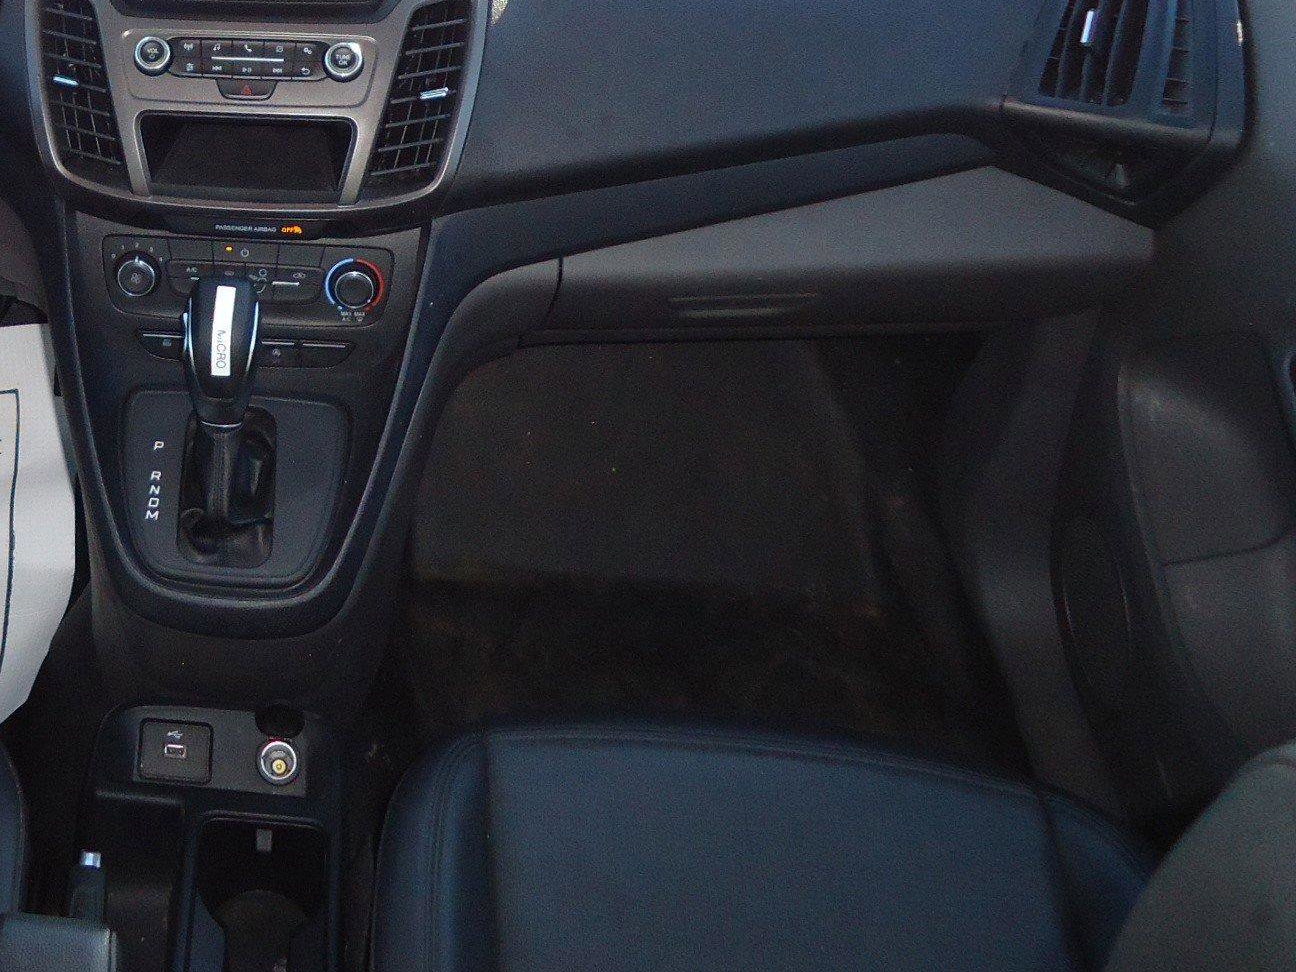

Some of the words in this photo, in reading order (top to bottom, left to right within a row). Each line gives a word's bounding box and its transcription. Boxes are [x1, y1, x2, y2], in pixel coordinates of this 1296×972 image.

[215, 224, 252, 232] PASSENGER
[154, 440, 164, 450] P
[150, 470, 161, 480] R
[149, 484, 160, 494] N
[148, 497, 160, 507] D
[145, 510, 159, 520] M
